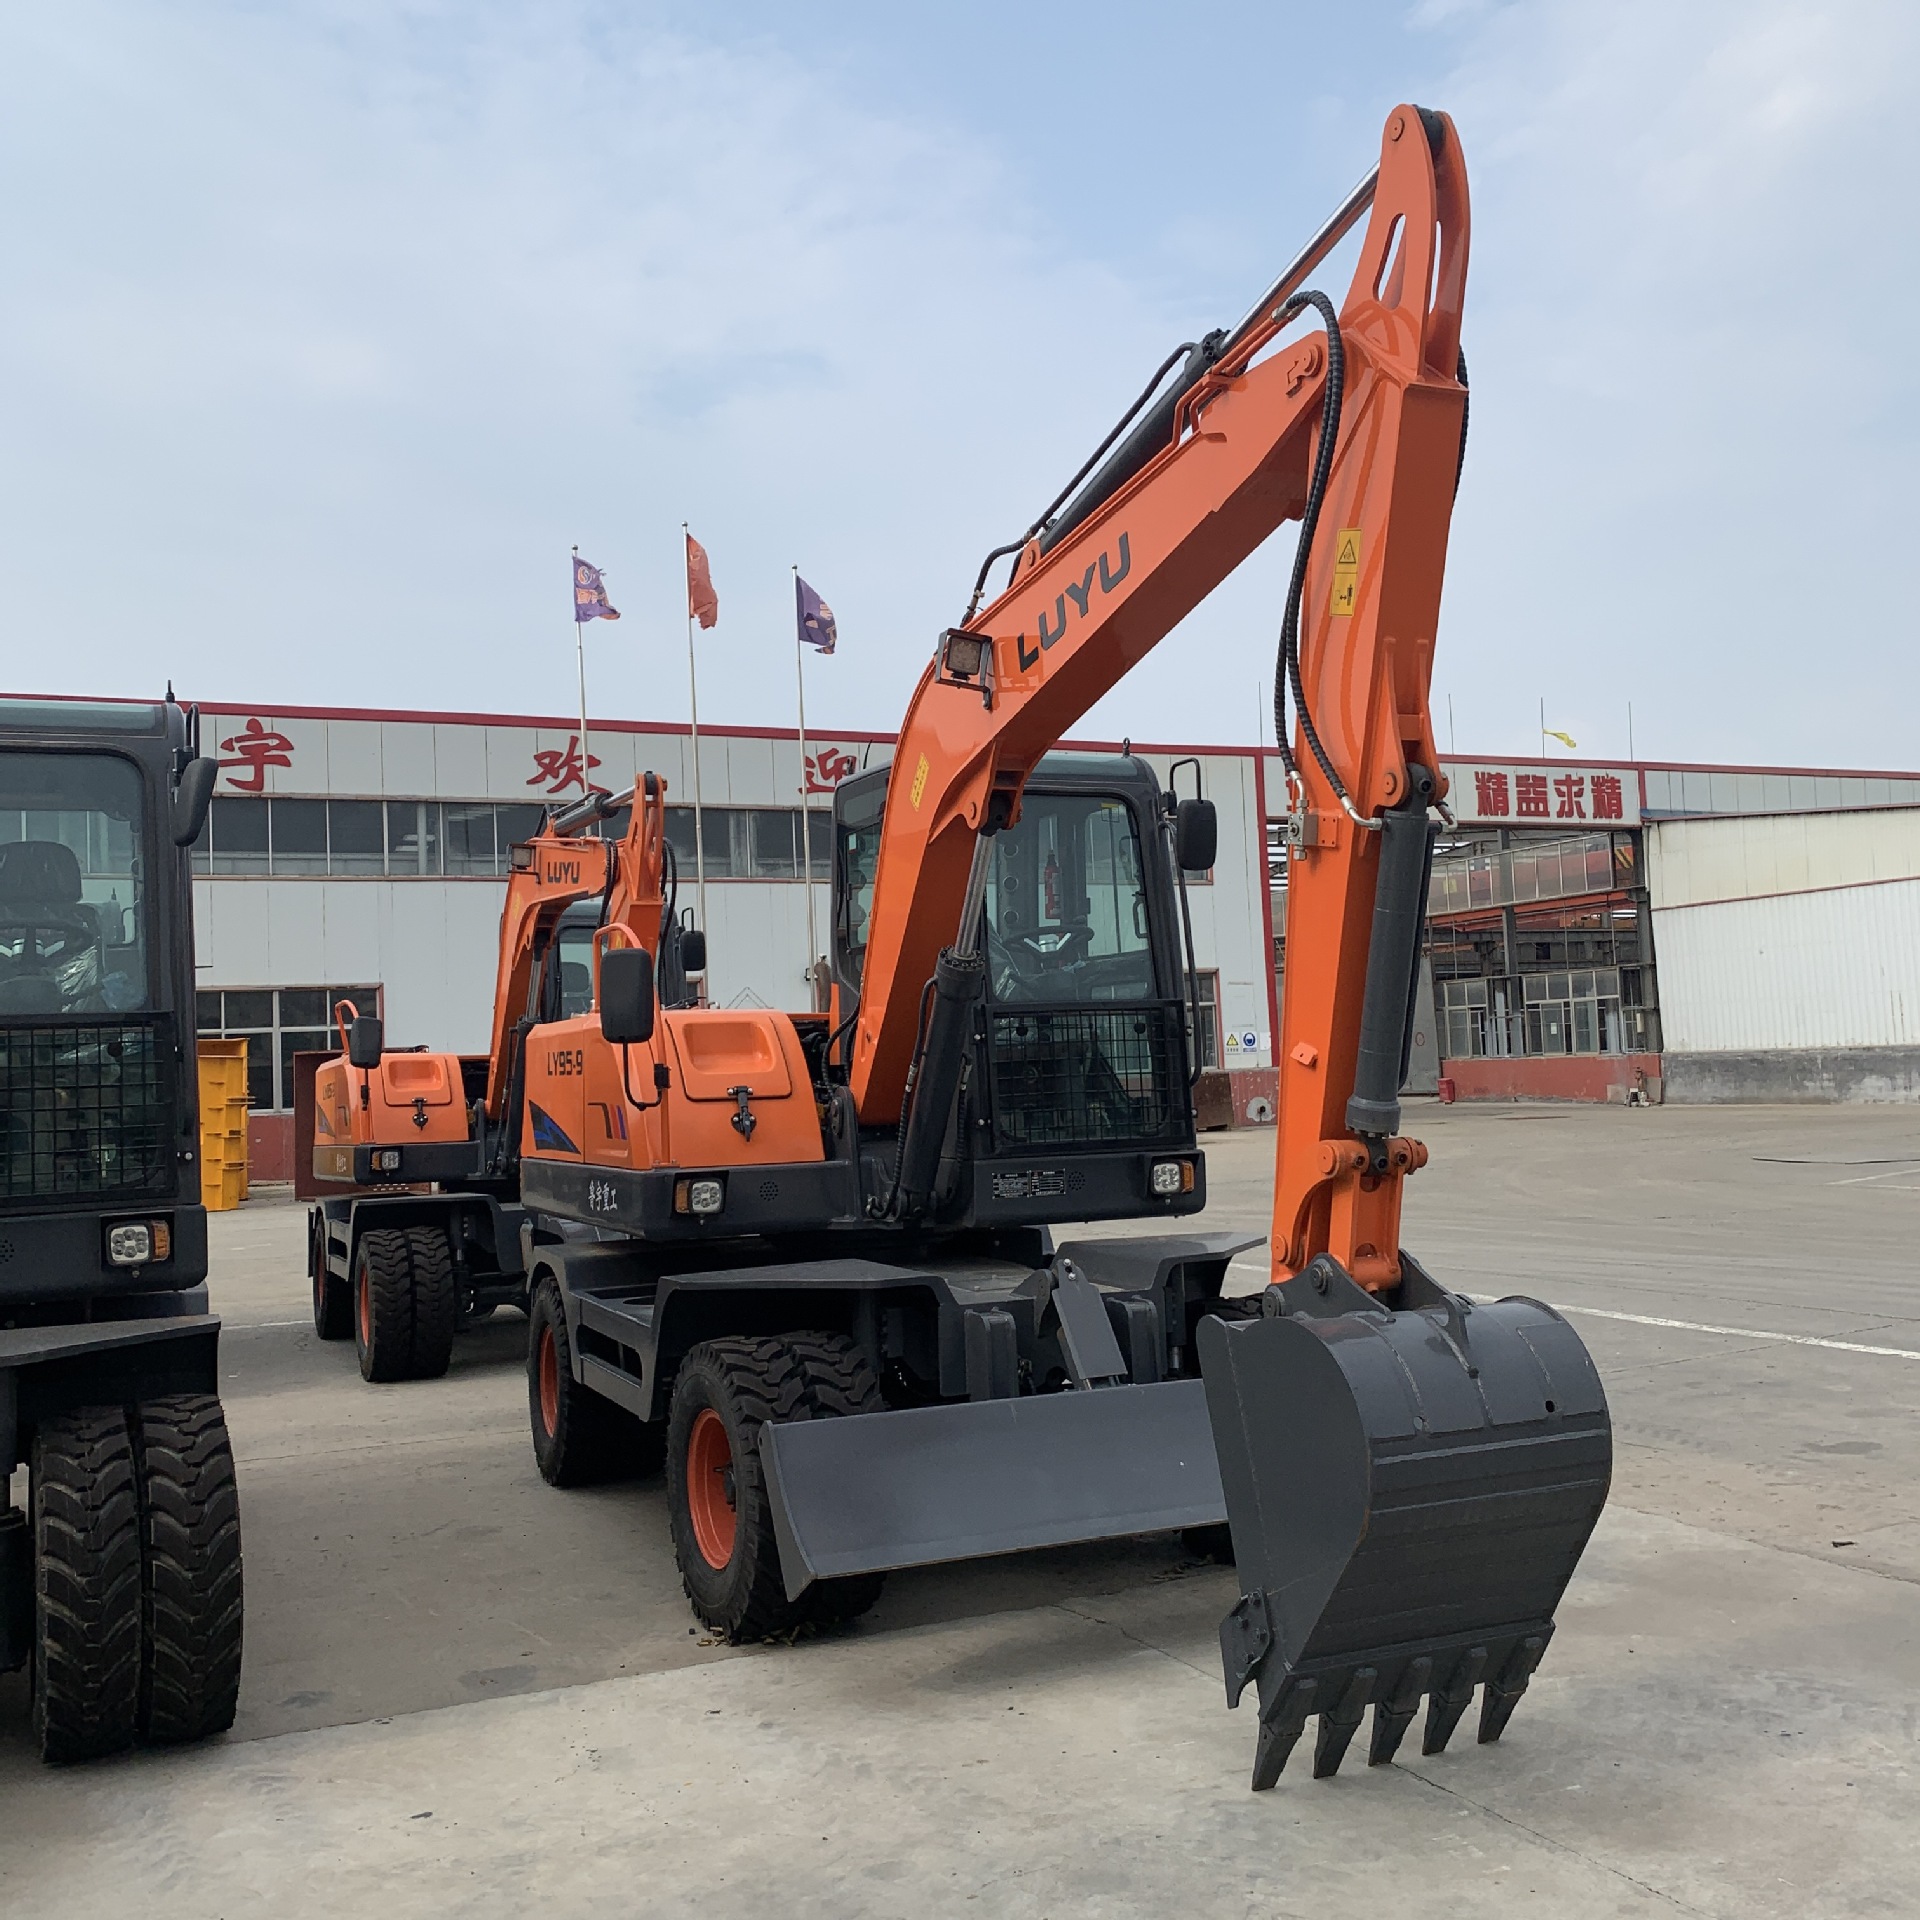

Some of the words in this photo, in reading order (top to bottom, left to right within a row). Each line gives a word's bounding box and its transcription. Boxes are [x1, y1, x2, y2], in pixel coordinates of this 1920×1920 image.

[1017, 531, 1131, 673] LUYU
[1474, 770, 1624, 820] 精益求精
[547, 861, 581, 885] LUYU
[547, 1049, 583, 1077] LY95-9
